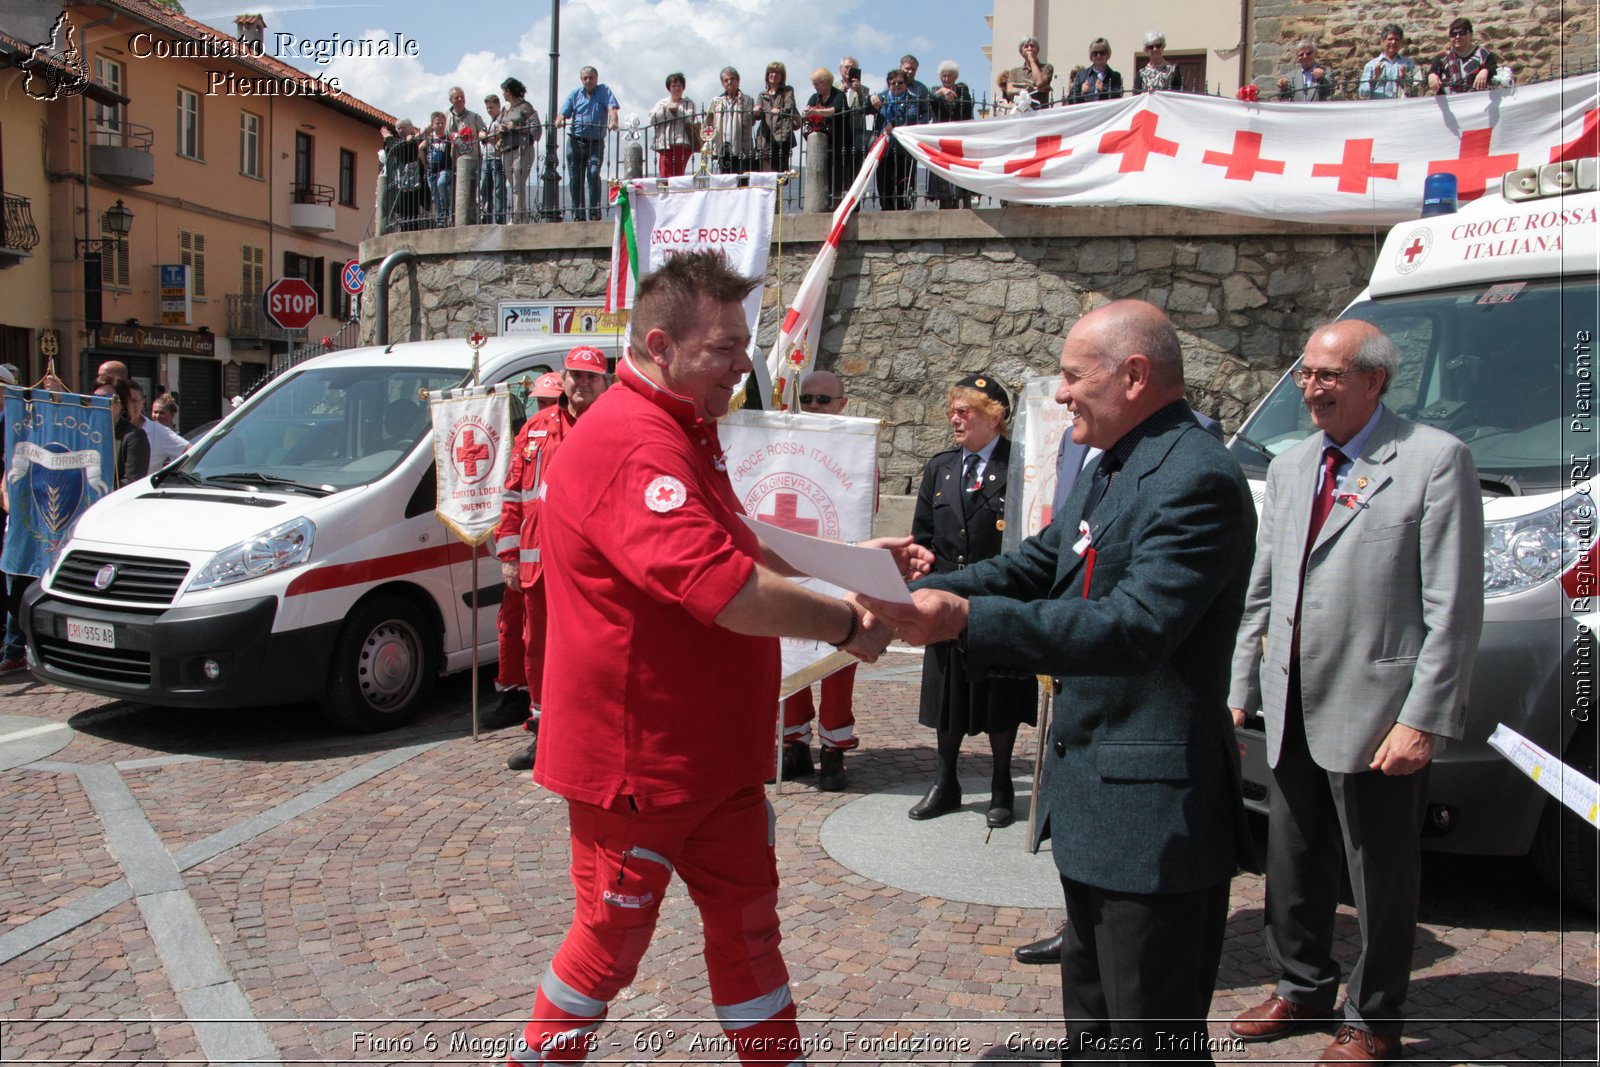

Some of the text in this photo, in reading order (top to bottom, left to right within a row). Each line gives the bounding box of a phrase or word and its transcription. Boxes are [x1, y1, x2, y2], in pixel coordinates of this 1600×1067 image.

[652, 226, 748, 244] CROCE ROSSA
[1451, 207, 1598, 241] CROCE ROSSA
[1463, 234, 1563, 260] ITALIANA
[273, 294, 315, 313] STOP
[101, 327, 213, 352] Antica Tabaccheria del Centro
[13, 413, 103, 444] PRO LOCO
[471, 415, 501, 443] ITALIANA
[23, 446, 95, 467] FIANO TORINESE
[733, 442, 853, 492] CROCE ROSSA ITALIANA
[479, 486, 503, 496] LOCALE
[760, 483, 769, 494] DI
[770, 476, 812, 496] GINEVRA
[812, 490, 826, 505] 22
[822, 505, 837, 538] AGOS
